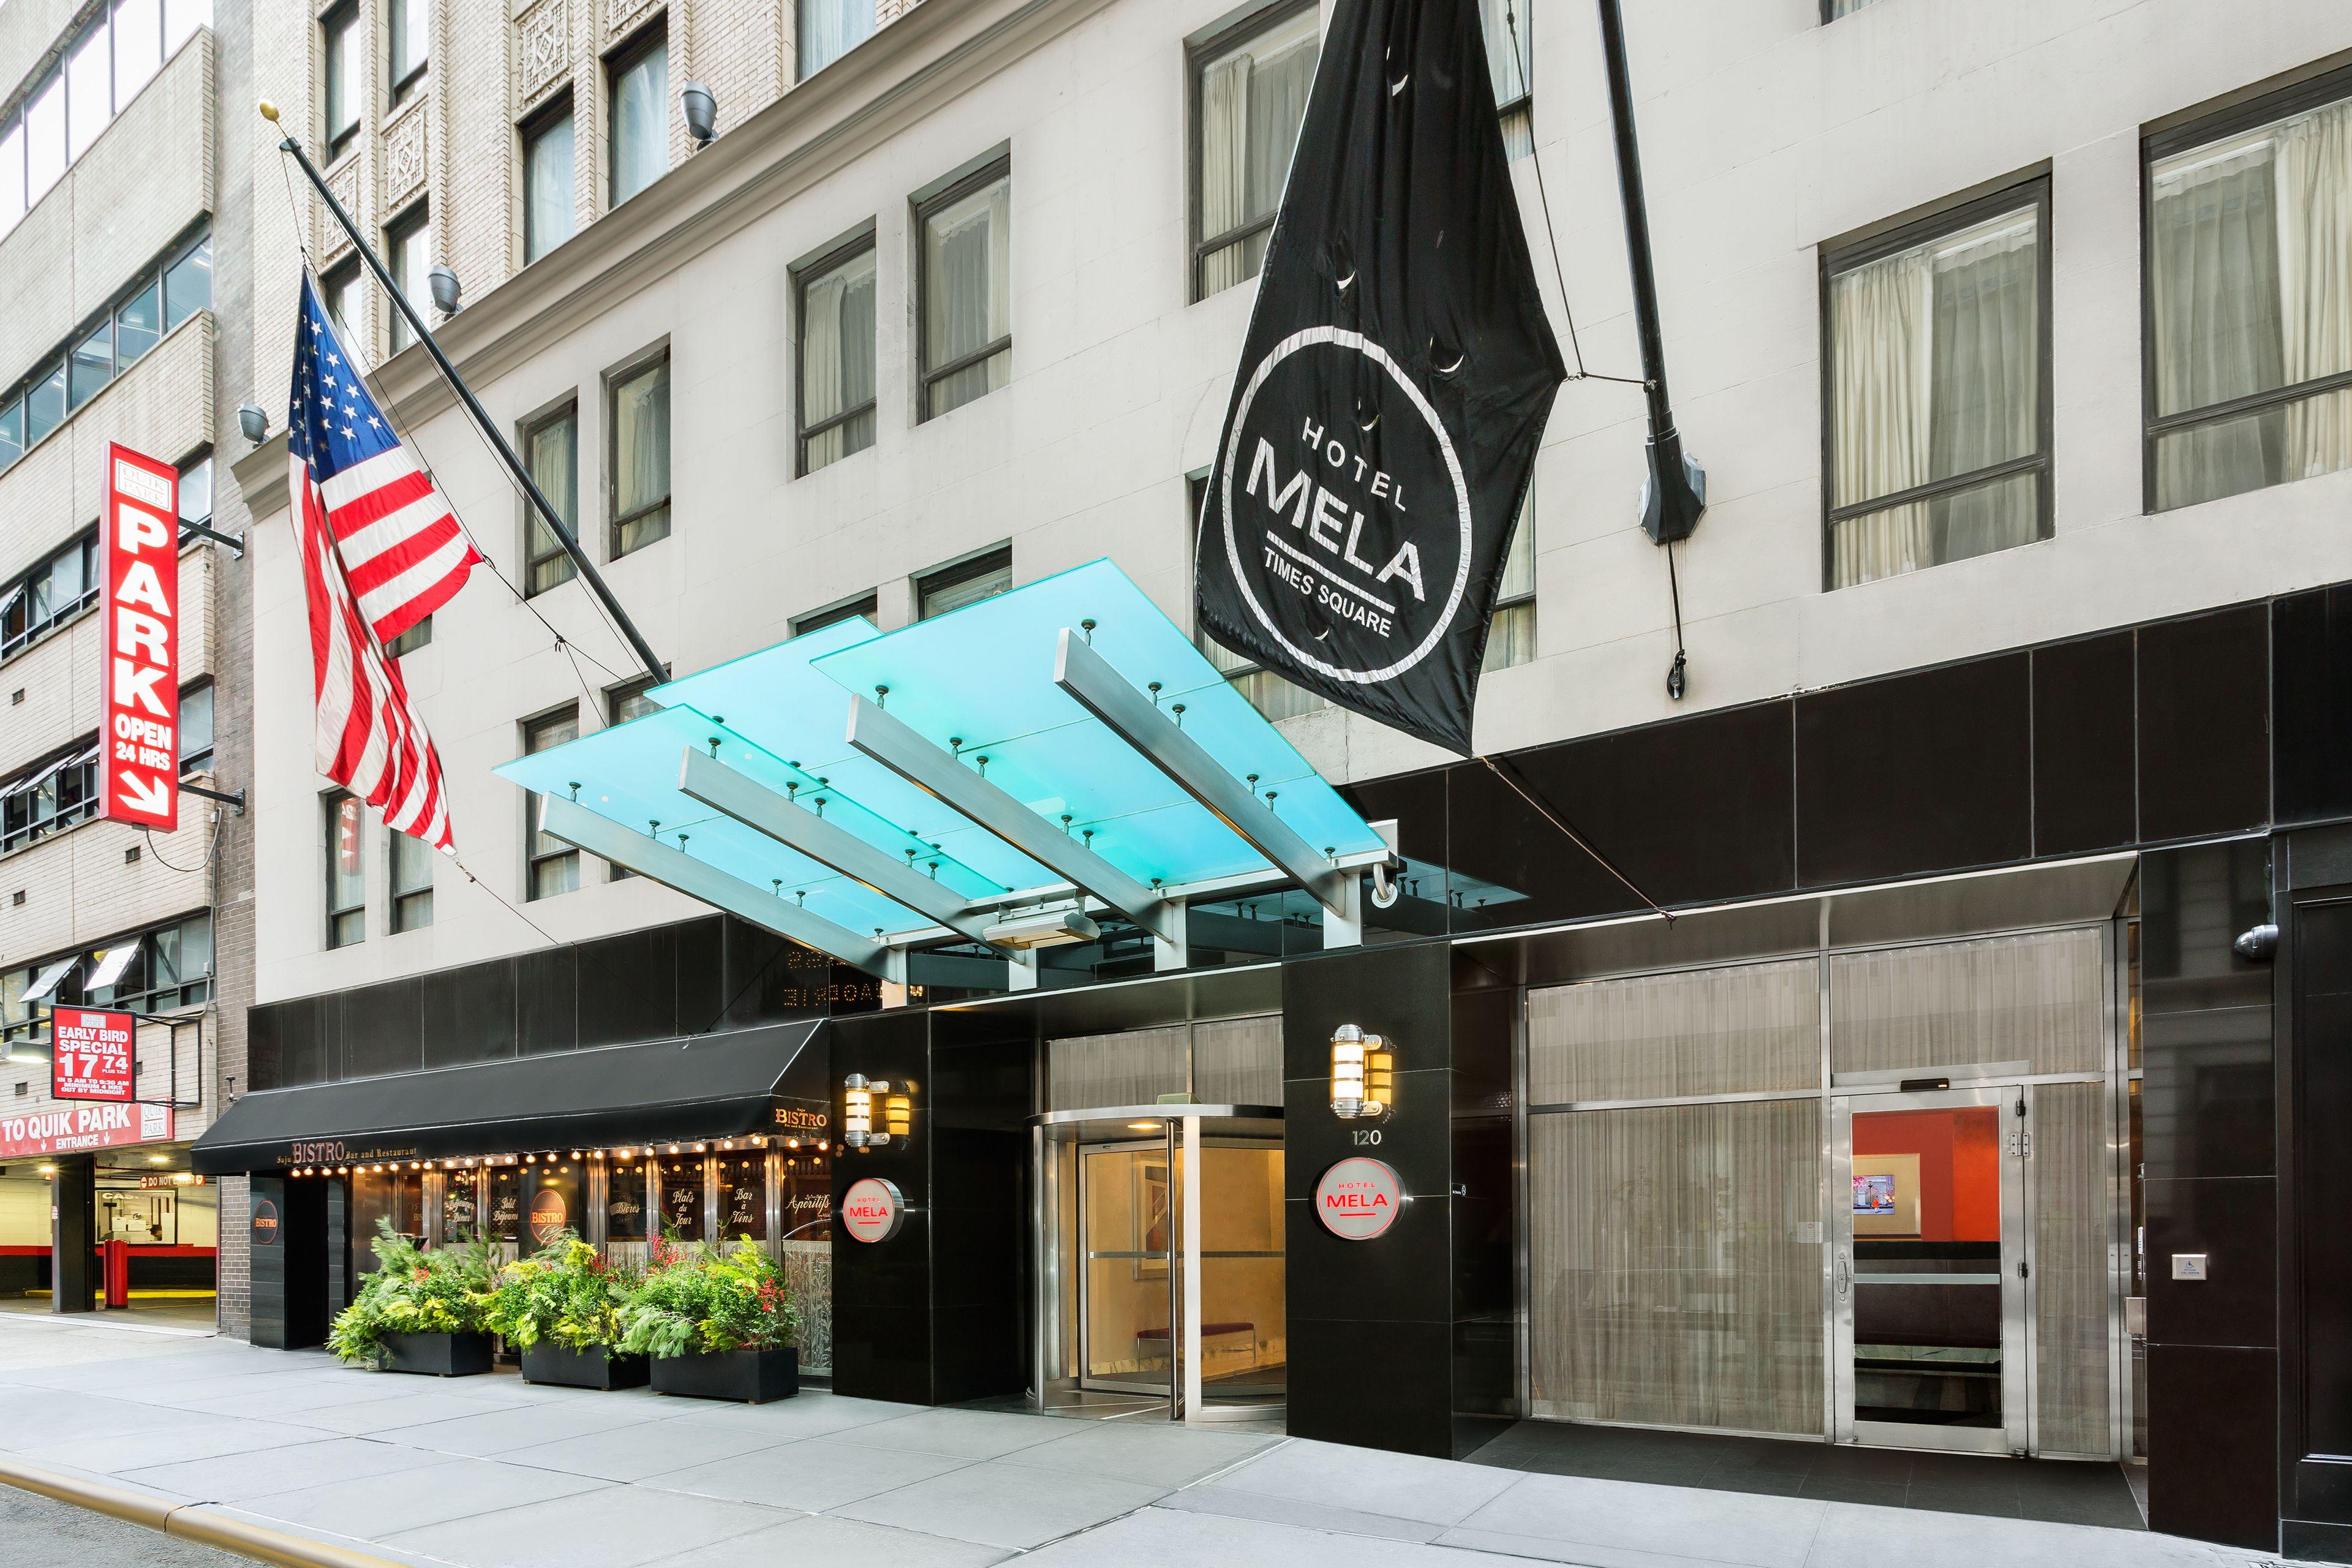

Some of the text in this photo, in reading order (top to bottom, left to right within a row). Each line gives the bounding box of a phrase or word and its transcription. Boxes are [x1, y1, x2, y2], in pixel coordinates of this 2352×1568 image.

[1302, 417, 1406, 511] HOTEL
[123, 467, 163, 491] QUIK
[124, 481, 163, 505] PARK
[1246, 437, 1425, 601] MELA
[1264, 547, 1392, 638] TIMES SQUARE
[115, 502, 172, 718] PARK
[115, 714, 172, 751] OPEN
[116, 745, 170, 771] 24 HRS
[58, 1026, 128, 1042] EARLY BIRD
[59, 1039, 127, 1055] SPECIAL
[59, 1053, 128, 1078] 17 74
[144, 1104, 163, 1117] QUIK
[775, 1108, 827, 1127] BISTRO
[2, 1103, 131, 1142] TO QUIK PARK
[144, 1122, 164, 1135] PARK
[56, 1134, 99, 1150] ENTRANCE
[1352, 1129, 1382, 1145] 120
[277, 1156, 292, 1165] Saju
[292, 1140, 345, 1164] BISTRO
[346, 1150, 358, 1159] Bar
[377, 1148, 417, 1157] Restaurant
[148, 1177, 158, 1186] DO
[159, 1175, 172, 1186] NOT
[673, 1188, 695, 1204] Plats
[734, 1188, 753, 1200] Bar
[1327, 1193, 1389, 1208] MELA
[501, 1196, 516, 1209] Petit
[679, 1204, 687, 1212] du
[532, 1212, 563, 1223] BISTRO
[673, 1213, 692, 1228] Jour
[733, 1211, 754, 1223] Vins
[850, 1207, 888, 1218] MELA
[255, 1218, 277, 1227] BISTRO
